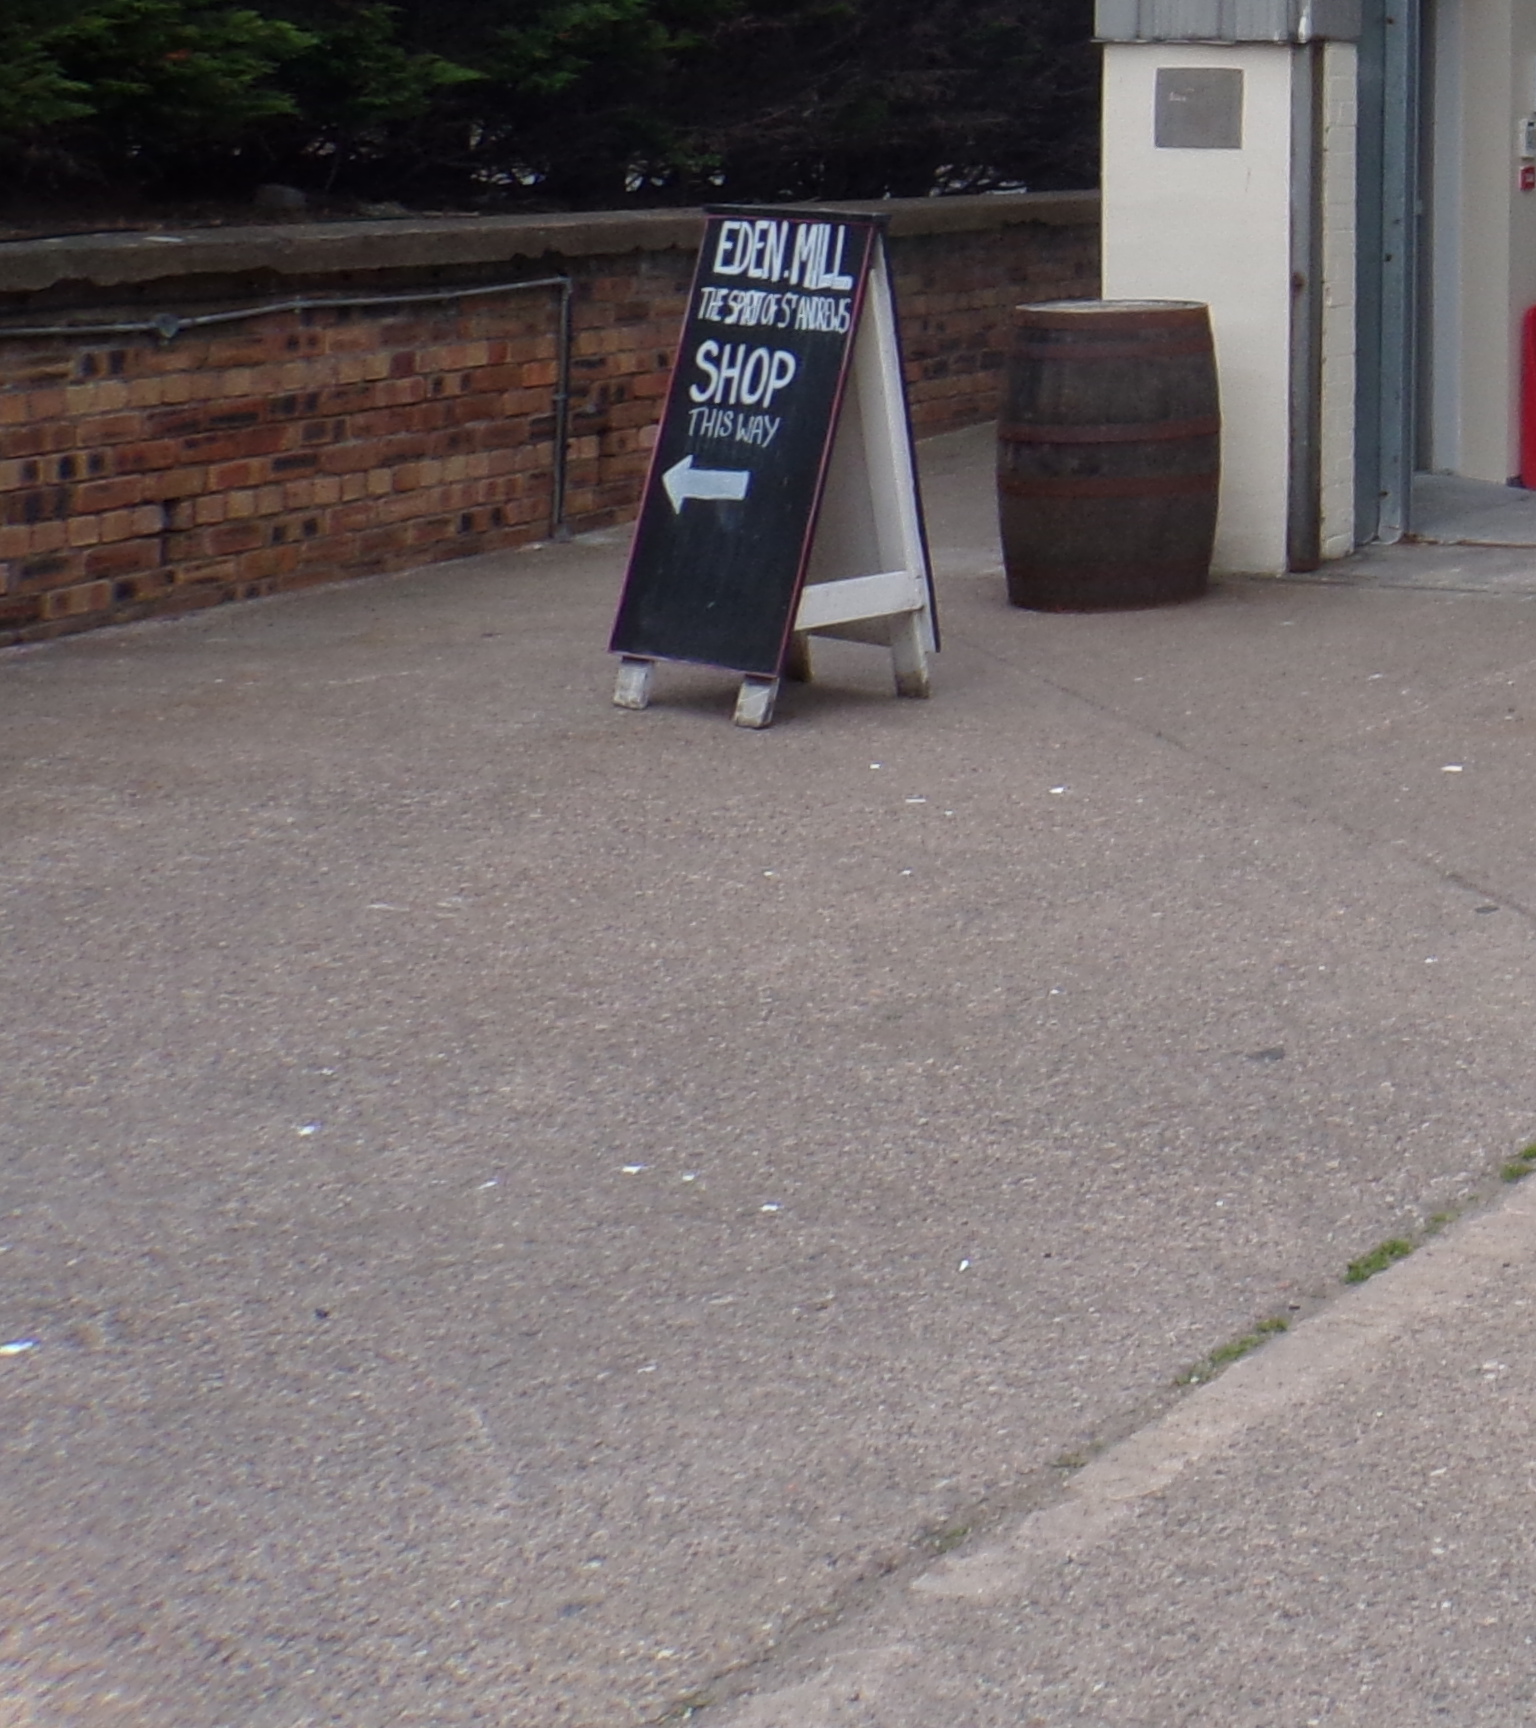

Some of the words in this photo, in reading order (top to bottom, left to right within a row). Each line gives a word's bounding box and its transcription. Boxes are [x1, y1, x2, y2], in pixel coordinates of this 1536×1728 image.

[698, 287, 728, 322] THE
[760, 293, 781, 326] OF
[795, 295, 852, 334] ANDREWS
[690, 340, 796, 408] SHOP
[689, 407, 734, 438] THIS
[735, 413, 780, 448] WAY
